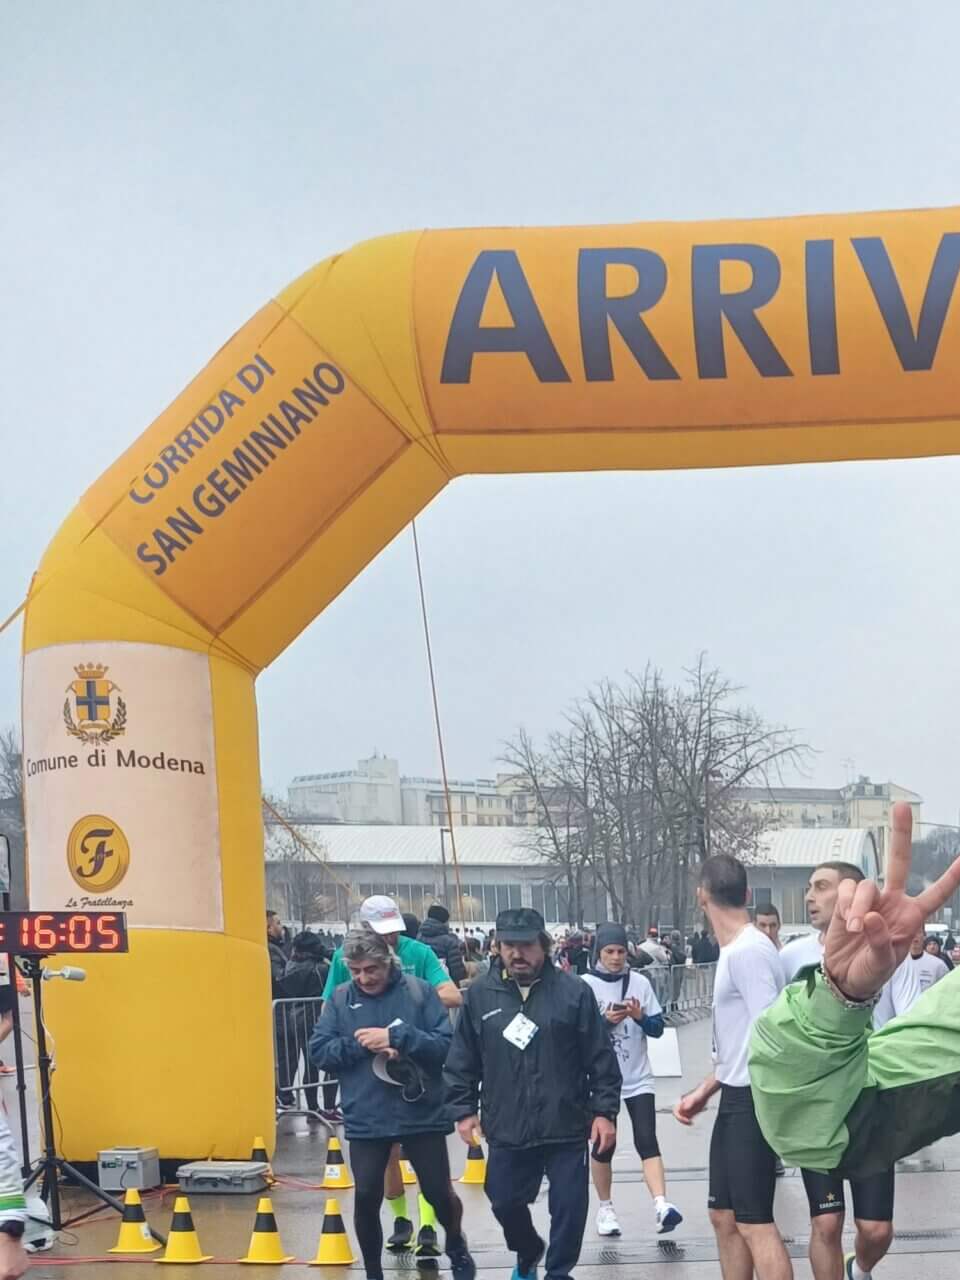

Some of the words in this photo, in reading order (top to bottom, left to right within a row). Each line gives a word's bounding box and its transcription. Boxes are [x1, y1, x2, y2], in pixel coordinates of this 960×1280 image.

[128, 389, 246, 505] CORRIDA
[235, 353, 276, 394] DI
[136, 506, 204, 576] SAN
[192, 362, 346, 519] GEMINIANO
[27, 751, 78, 778] Comune
[88, 749, 107, 768] di
[116, 750, 206, 775] Modena
[65, 897, 78, 908] La
[79, 896, 134, 909] Fratellanza
